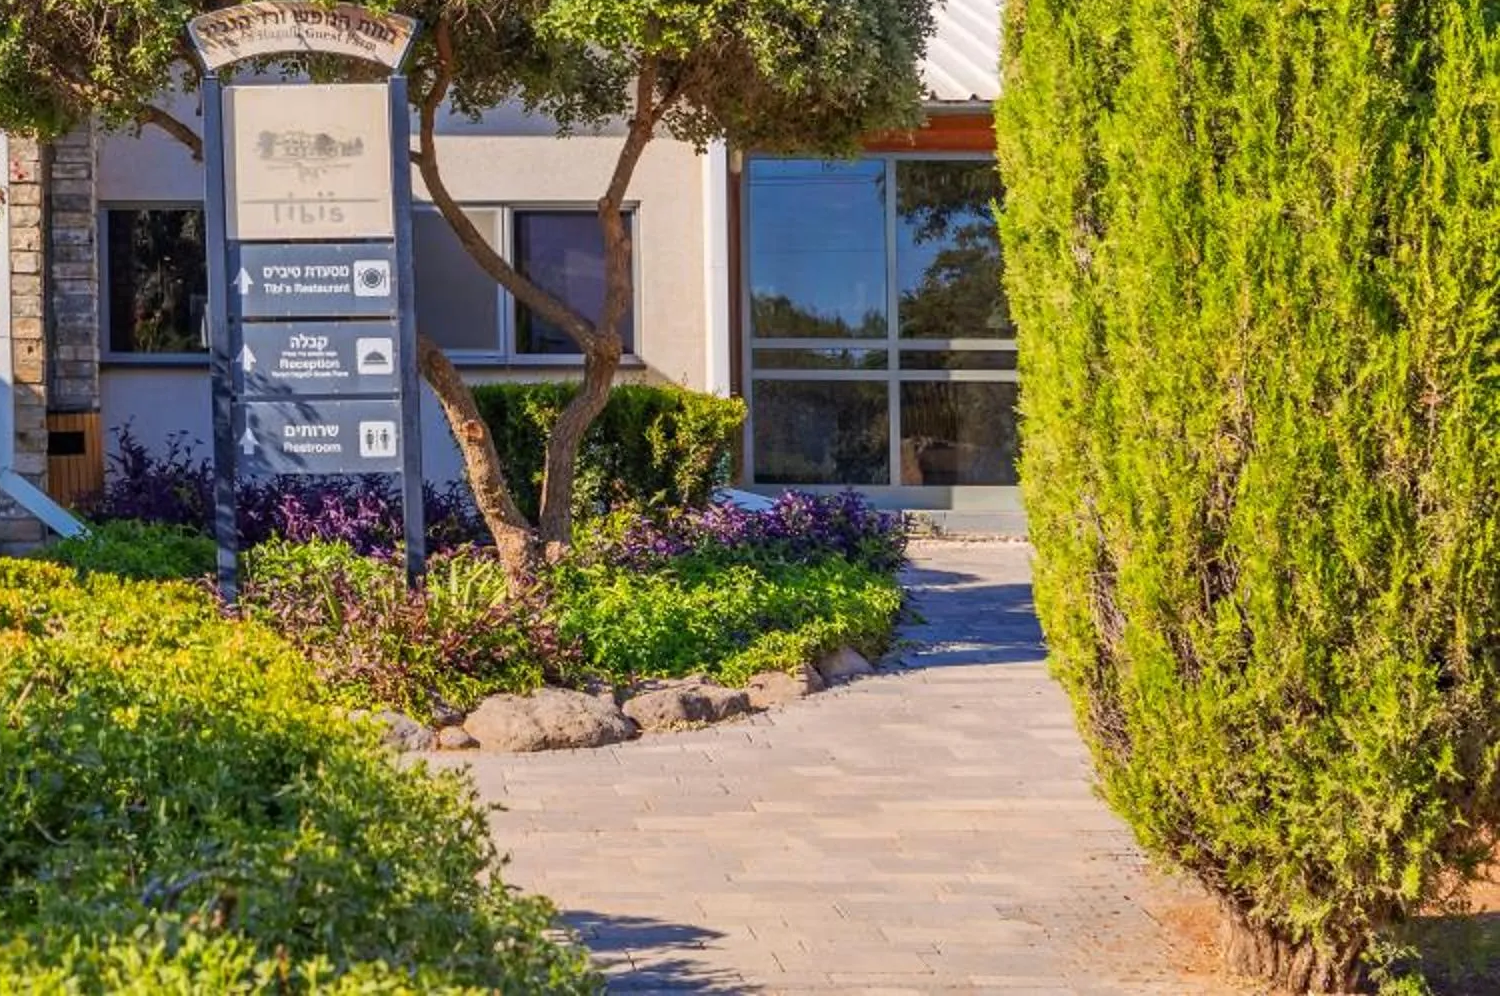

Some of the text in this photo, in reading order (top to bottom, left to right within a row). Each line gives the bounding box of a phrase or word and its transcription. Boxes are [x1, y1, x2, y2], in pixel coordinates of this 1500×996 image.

[304, 265, 349, 278] מסעדת
[294, 283, 350, 293] Restaurant
[289, 333, 328, 351] קבלה
[279, 358, 341, 370] Reception
[283, 424, 340, 437] שרותים
[283, 441, 342, 453] Restroom
